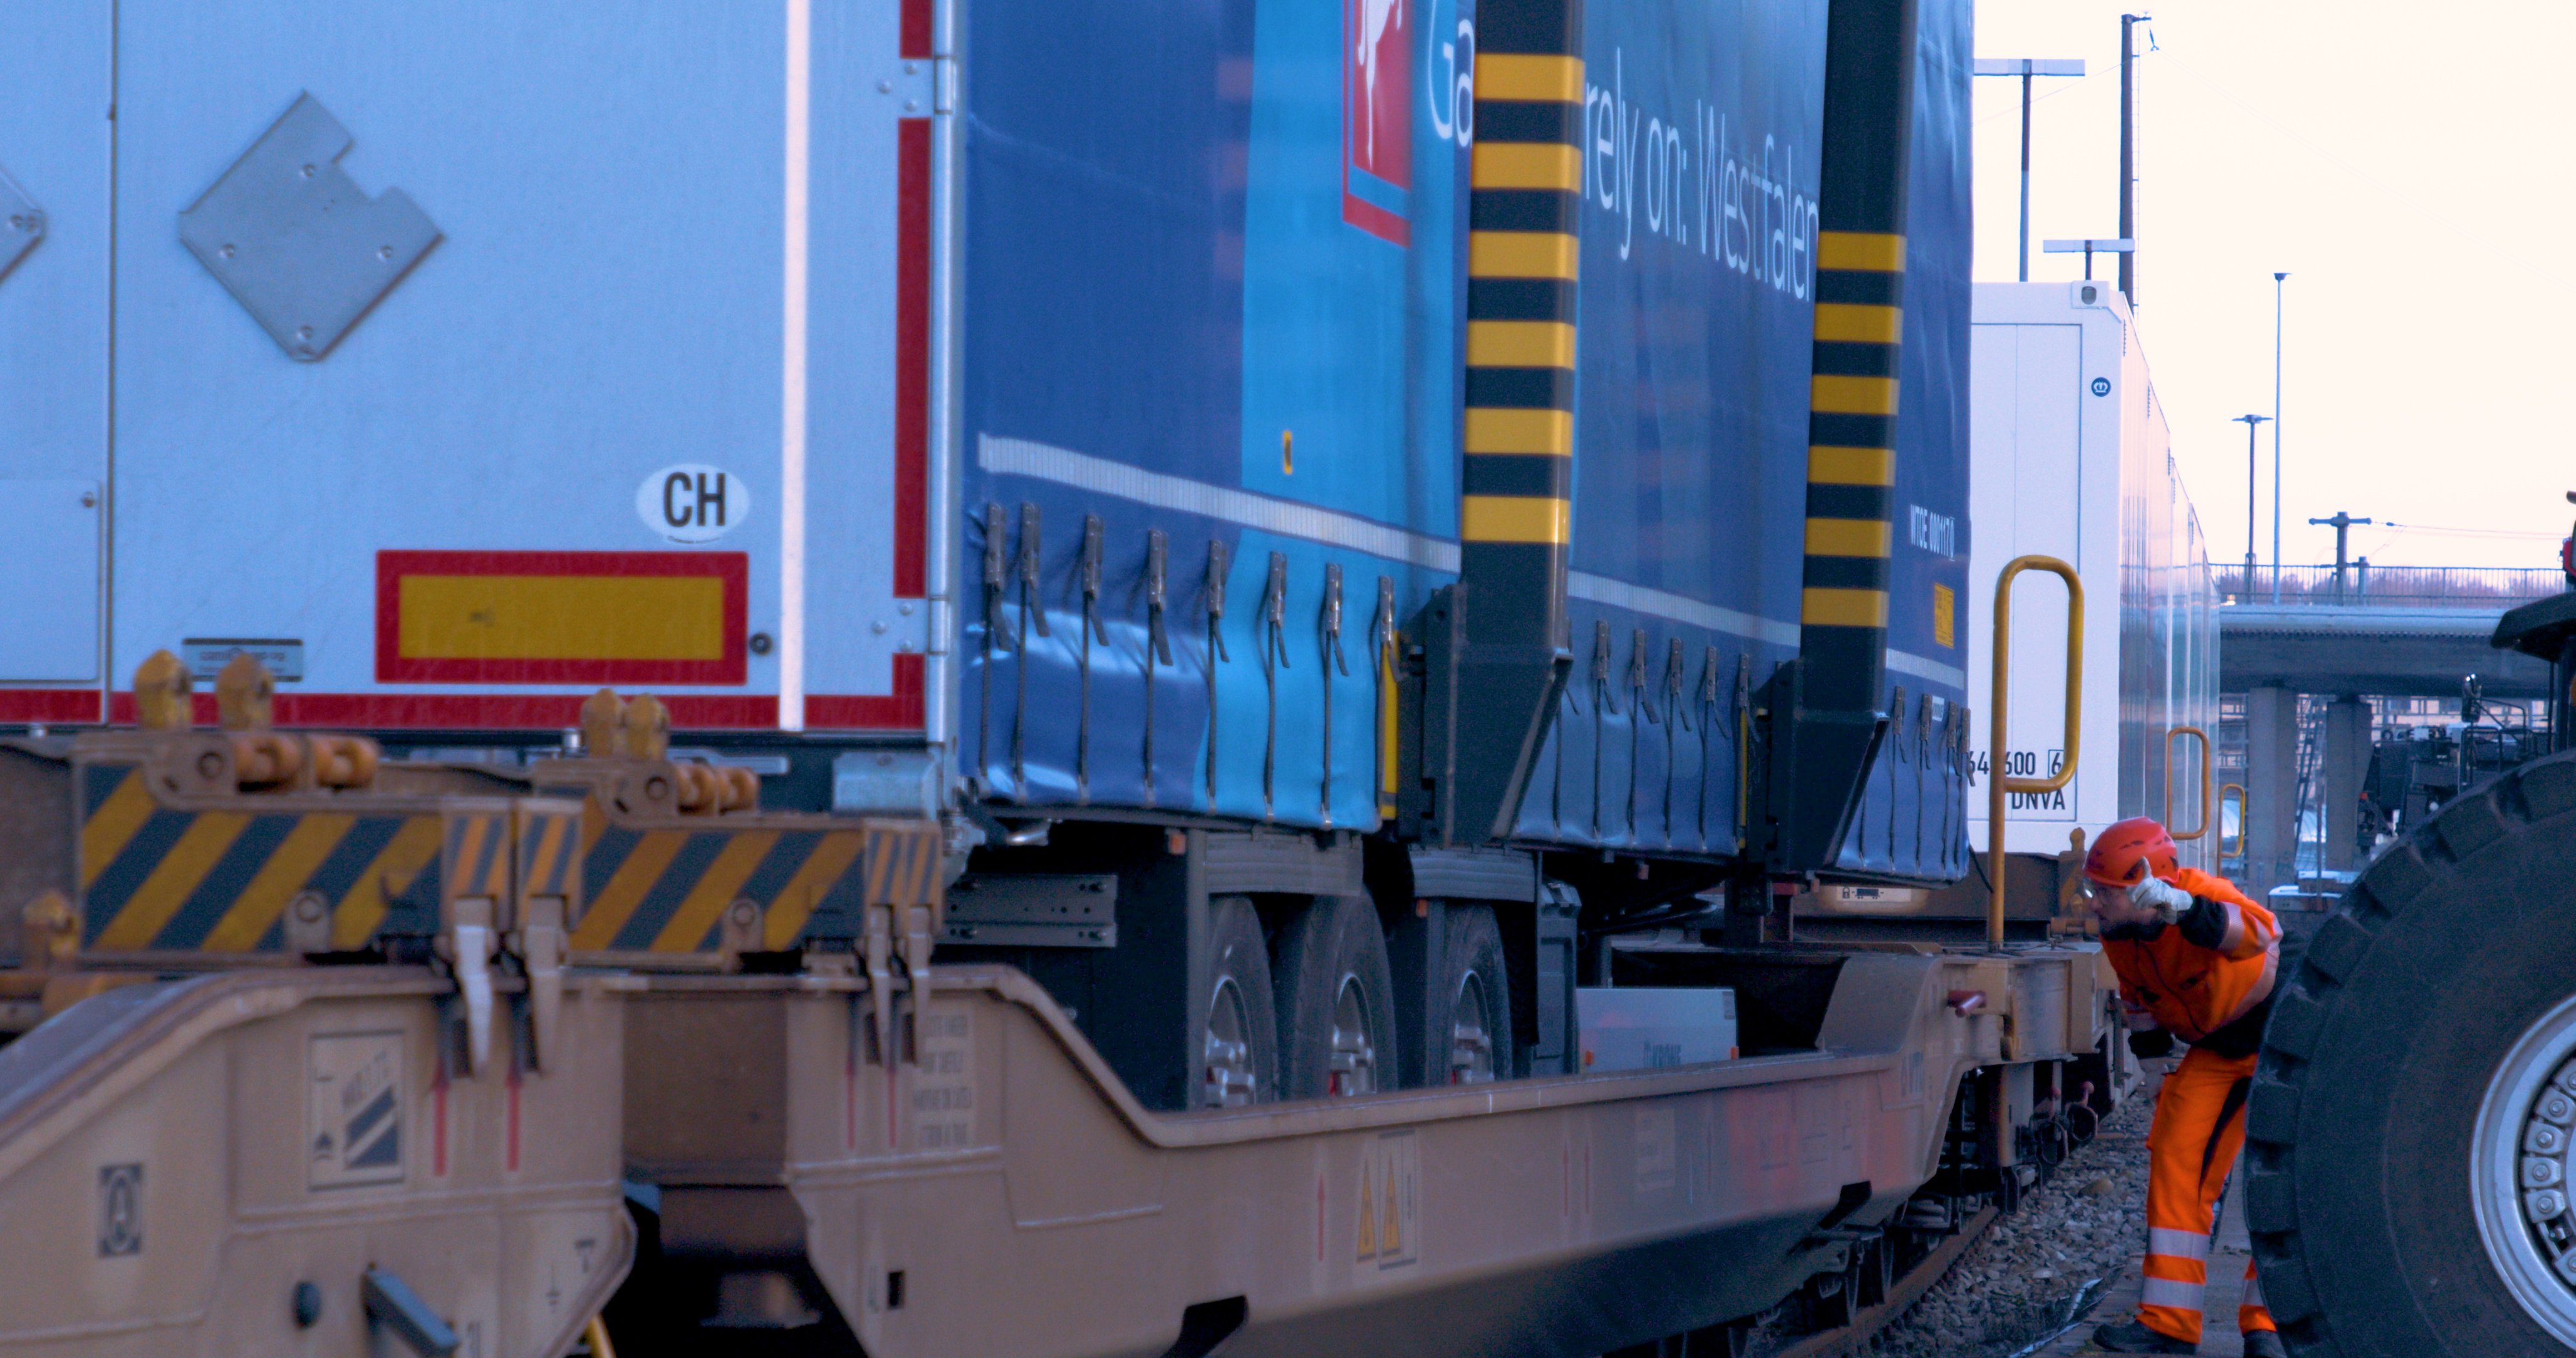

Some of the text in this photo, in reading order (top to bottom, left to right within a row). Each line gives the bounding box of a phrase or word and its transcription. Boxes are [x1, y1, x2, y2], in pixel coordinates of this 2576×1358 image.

[1585, 46, 1639, 261] rely
[1646, 117, 1687, 245] on:
[1696, 98, 1819, 302] Westfalen
[663, 472, 726, 528] CH
